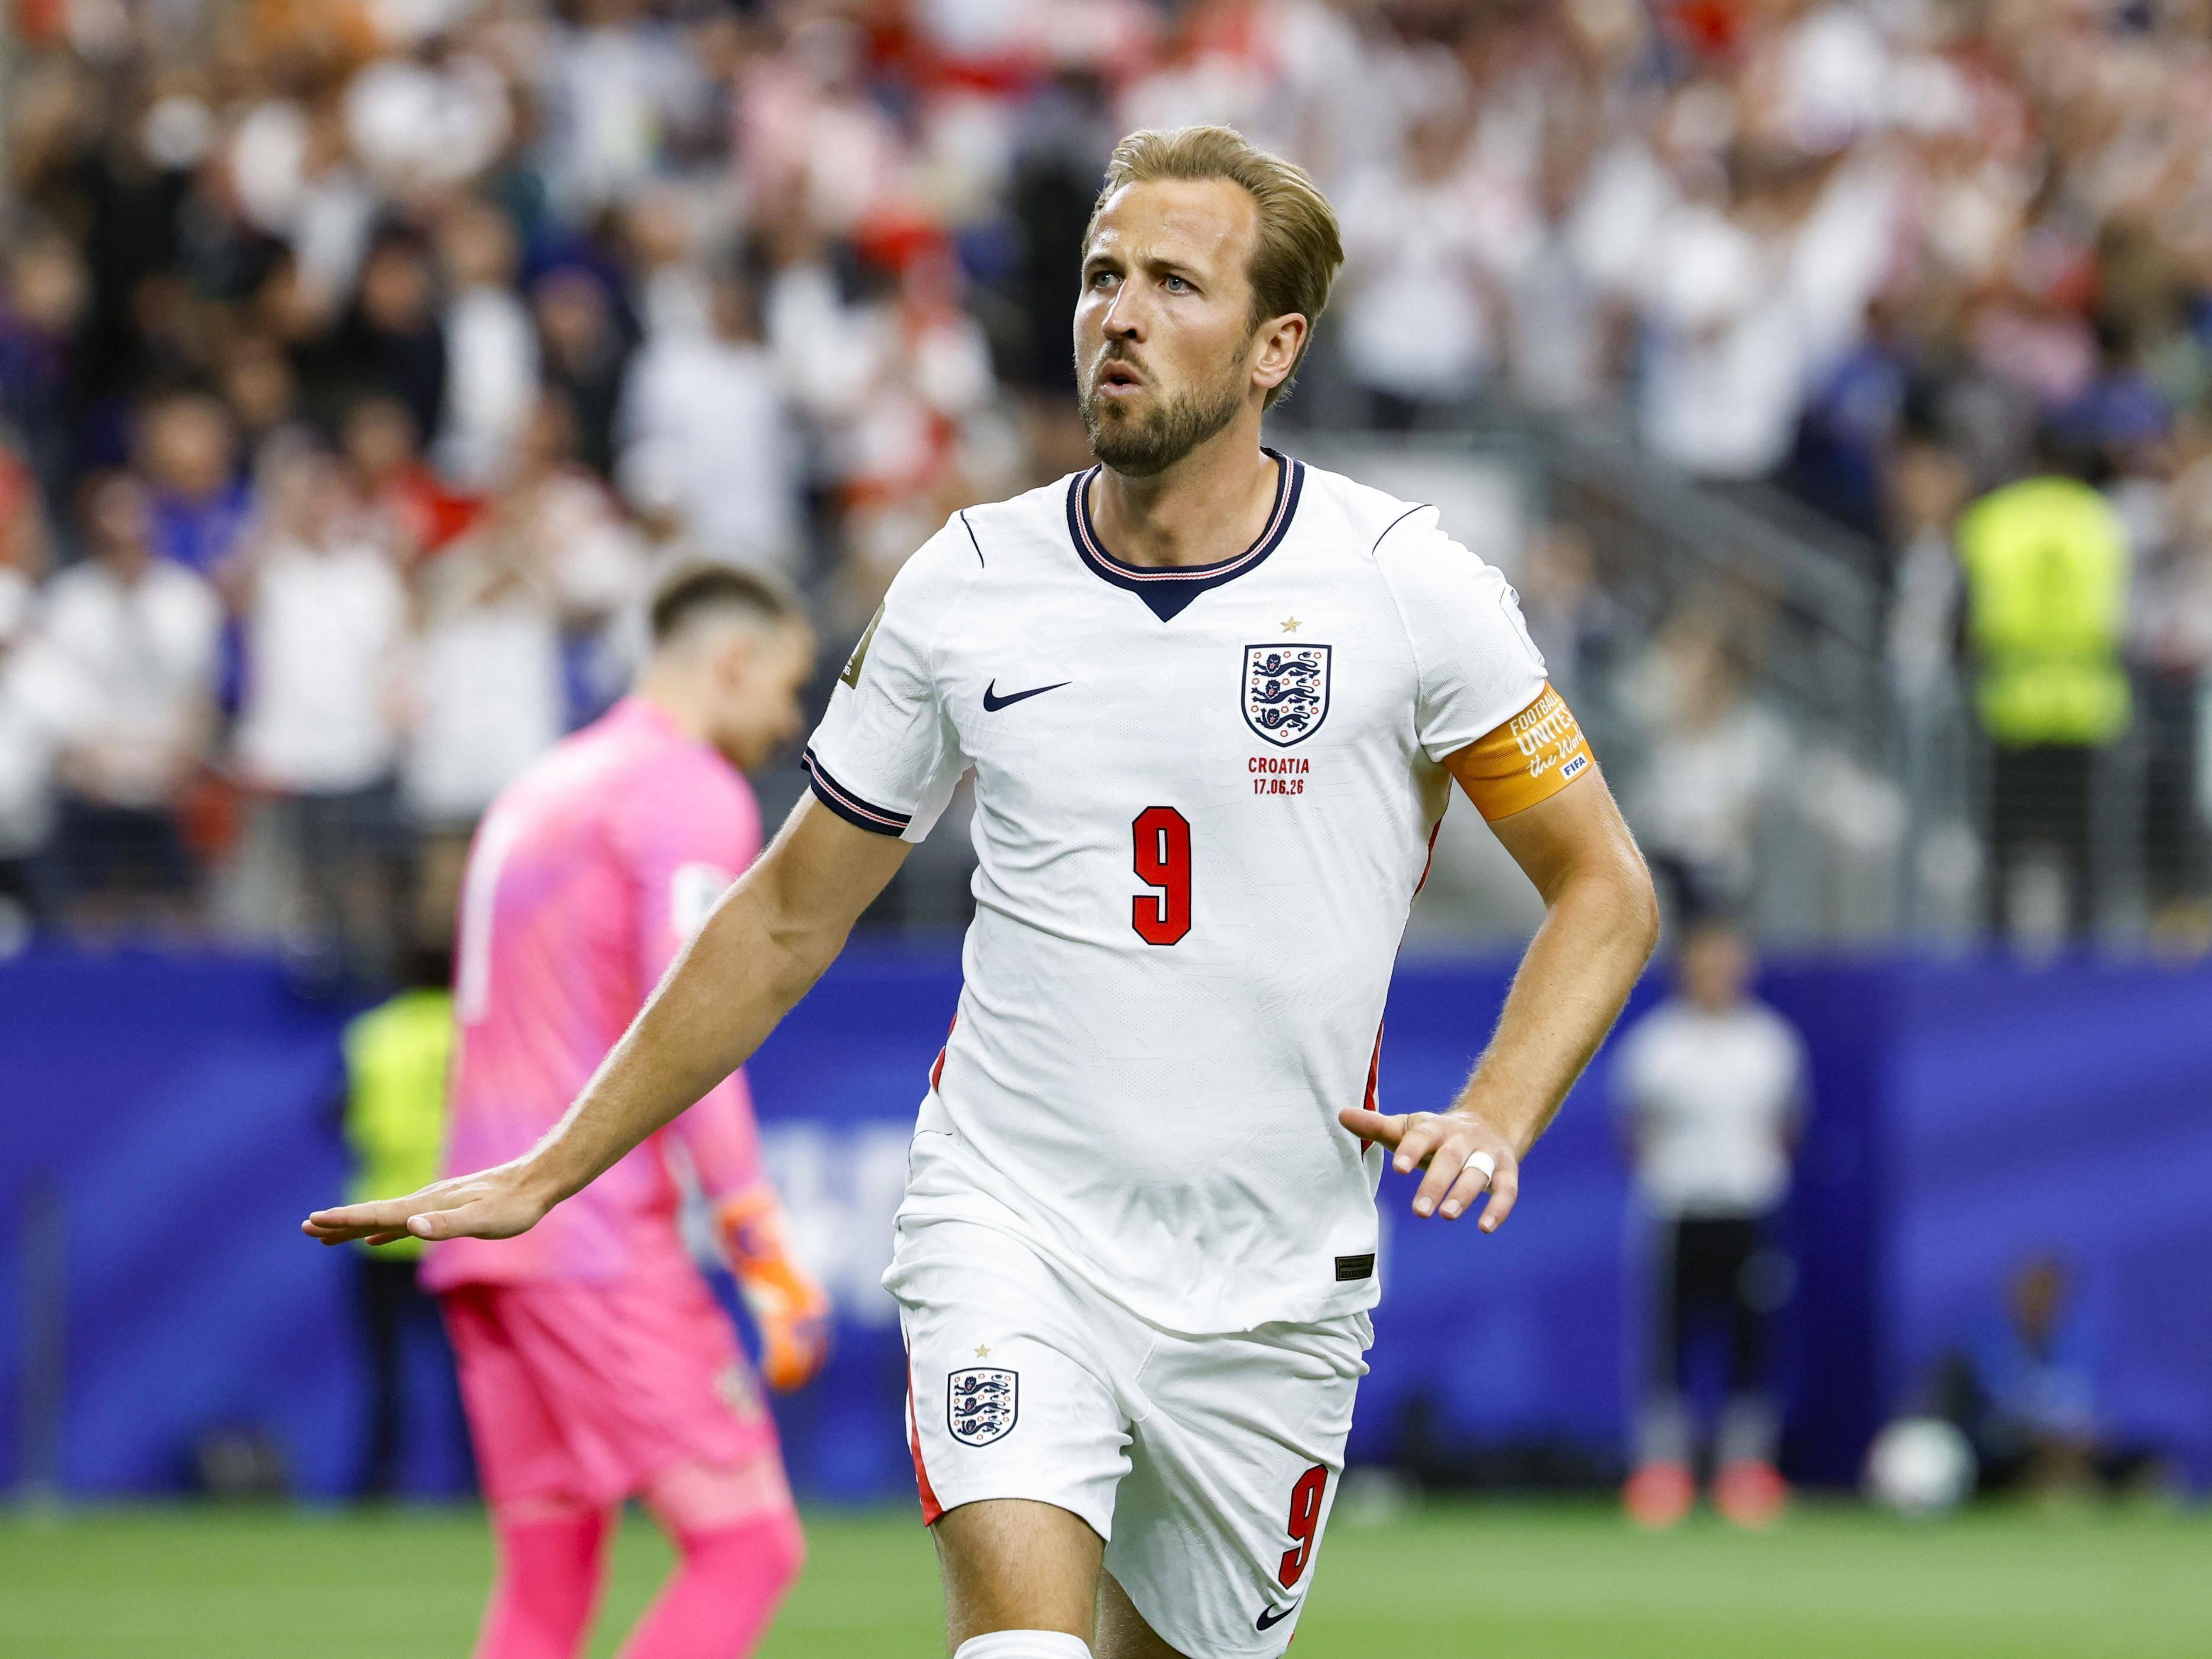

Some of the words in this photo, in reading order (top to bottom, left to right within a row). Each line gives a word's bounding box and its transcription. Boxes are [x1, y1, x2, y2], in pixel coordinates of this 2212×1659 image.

[1510, 689, 1559, 736] FOOTBALL
[1516, 702, 1573, 756] UNITES
[1248, 757, 1309, 774] CROATIA
[1527, 754, 1557, 777] the
[1563, 756, 1586, 776] FIFA
[1254, 779, 1304, 795] 17.06.26
[1132, 806, 1191, 946] 9
[1278, 1463, 1329, 1590] 9
